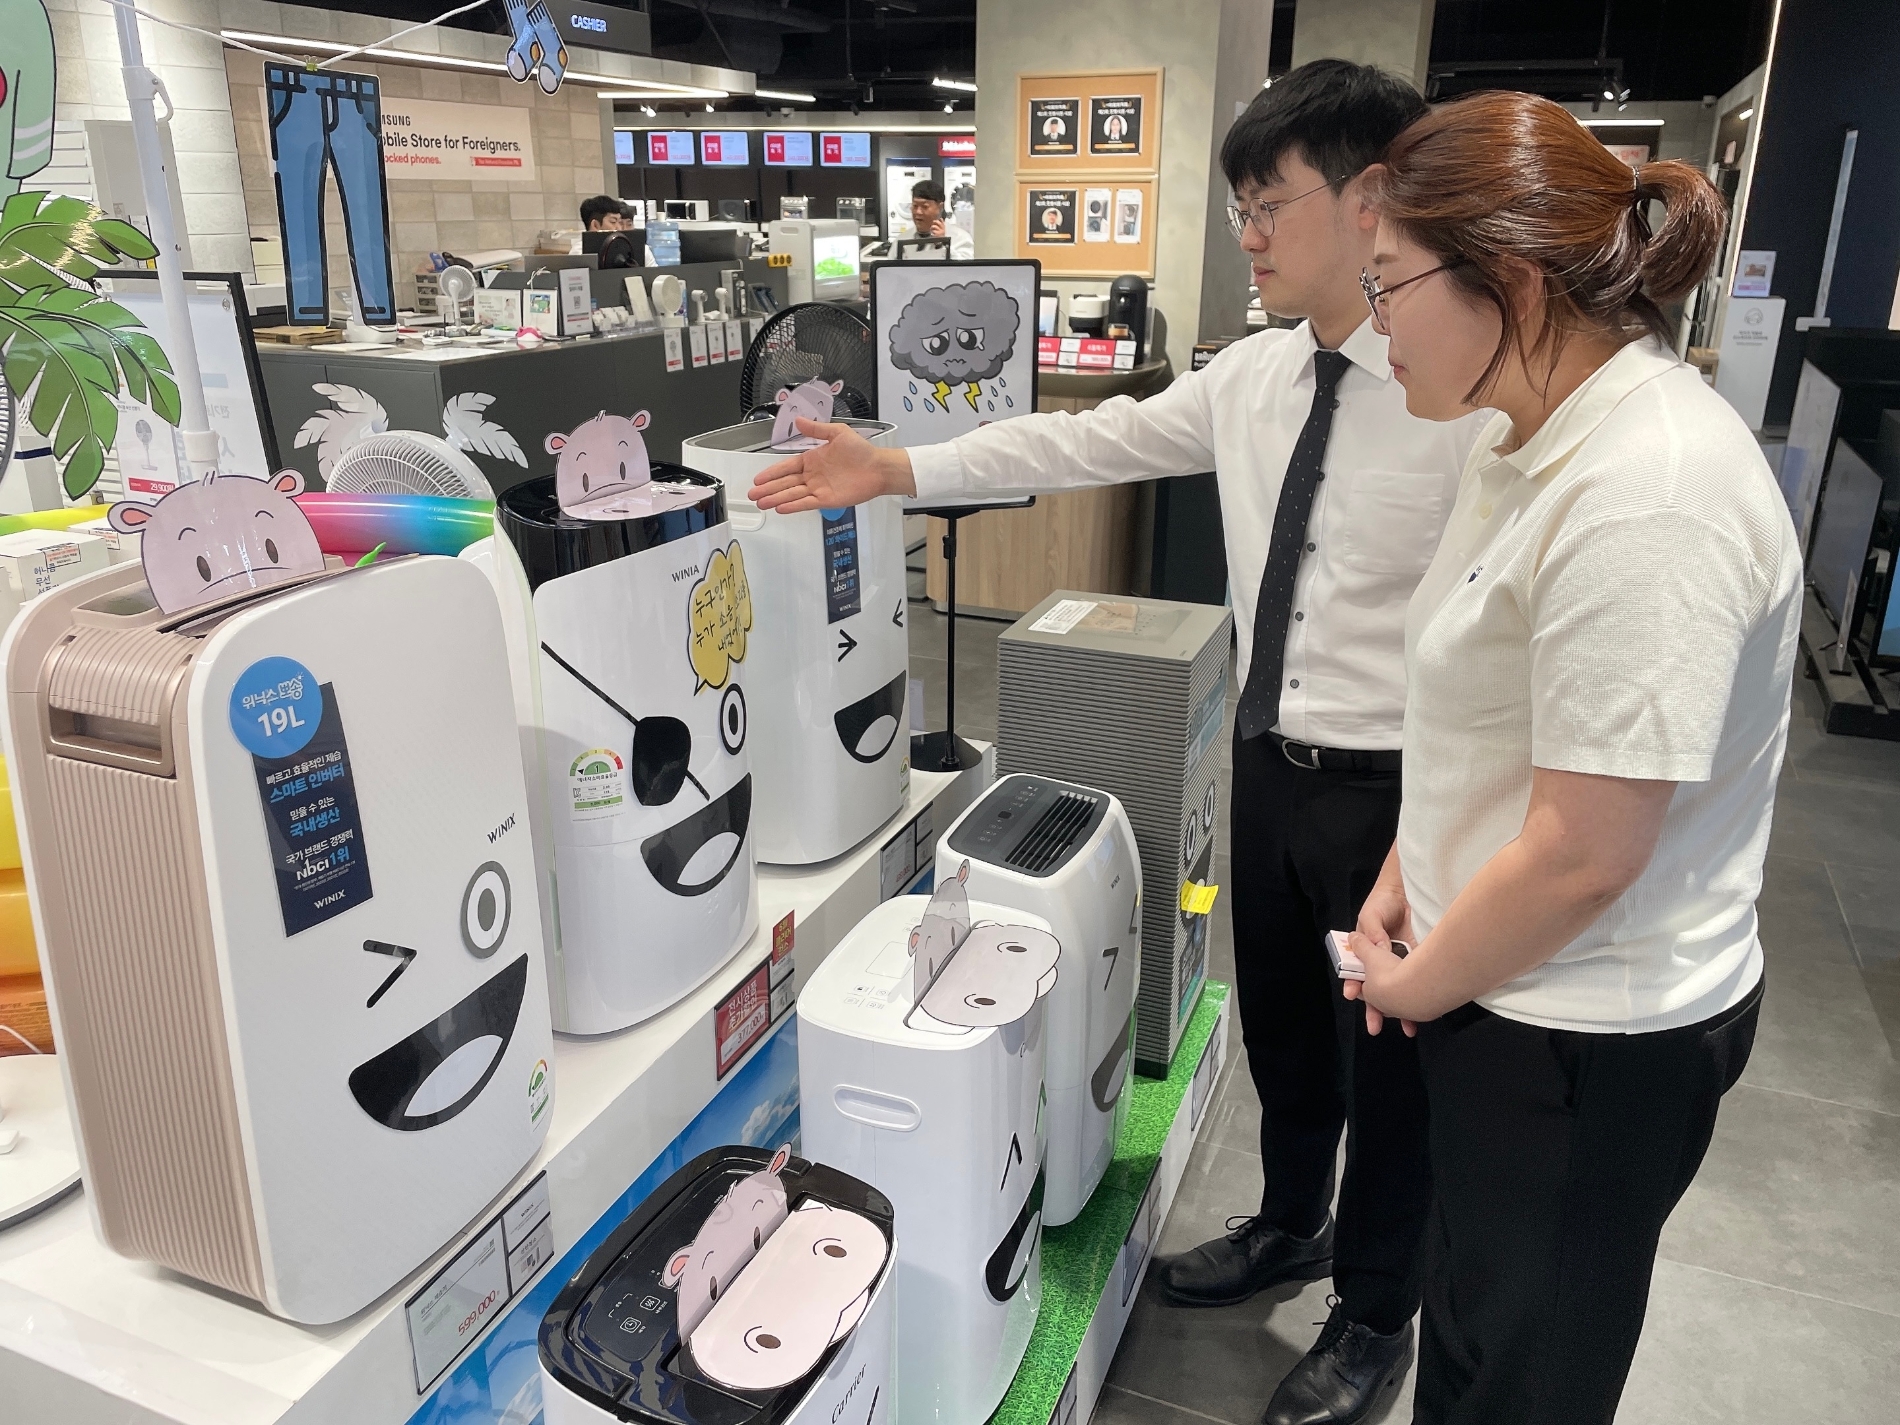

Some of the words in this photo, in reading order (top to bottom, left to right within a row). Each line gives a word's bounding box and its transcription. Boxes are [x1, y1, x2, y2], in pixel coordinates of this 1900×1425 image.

[571, 14, 607, 32] CASHIER
[382, 114, 411, 127] MSUNG
[383, 131, 408, 148] obile
[411, 133, 441, 149] Store
[444, 135, 460, 149] for
[462, 136, 522, 154] Foreigners.
[385, 152, 409, 164] ocked
[411, 154, 442, 166] phones.
[35, 575, 51, 587] 무선
[671, 564, 700, 582] WINIA
[696, 620, 715, 648] 누가
[242, 688, 279, 710] 위닉스
[257, 705, 306, 738] 19L
[265, 768, 293, 786] 빠르고
[292, 755, 326, 778] 효율적인
[325, 750, 342, 764] 제습
[270, 777, 309, 804] 스마트
[308, 762, 345, 790] 인버터
[289, 806, 308, 821] 믿을
[308, 802, 318, 814] 수
[318, 796, 335, 810] 있는
[289, 806, 342, 838] 국내생산
[487, 812, 516, 844] WINIX
[285, 850, 304, 865] 국가
[304, 839, 330, 858] 브랜드
[329, 828, 354, 848] 경쟁력
[329, 845, 351, 867] 1위
[313, 889, 347, 910] WINIX
[728, 979, 757, 1016] 전시상품
[458, 1290, 497, 1337] 599,000
[831, 1362, 867, 1424] Carrier
